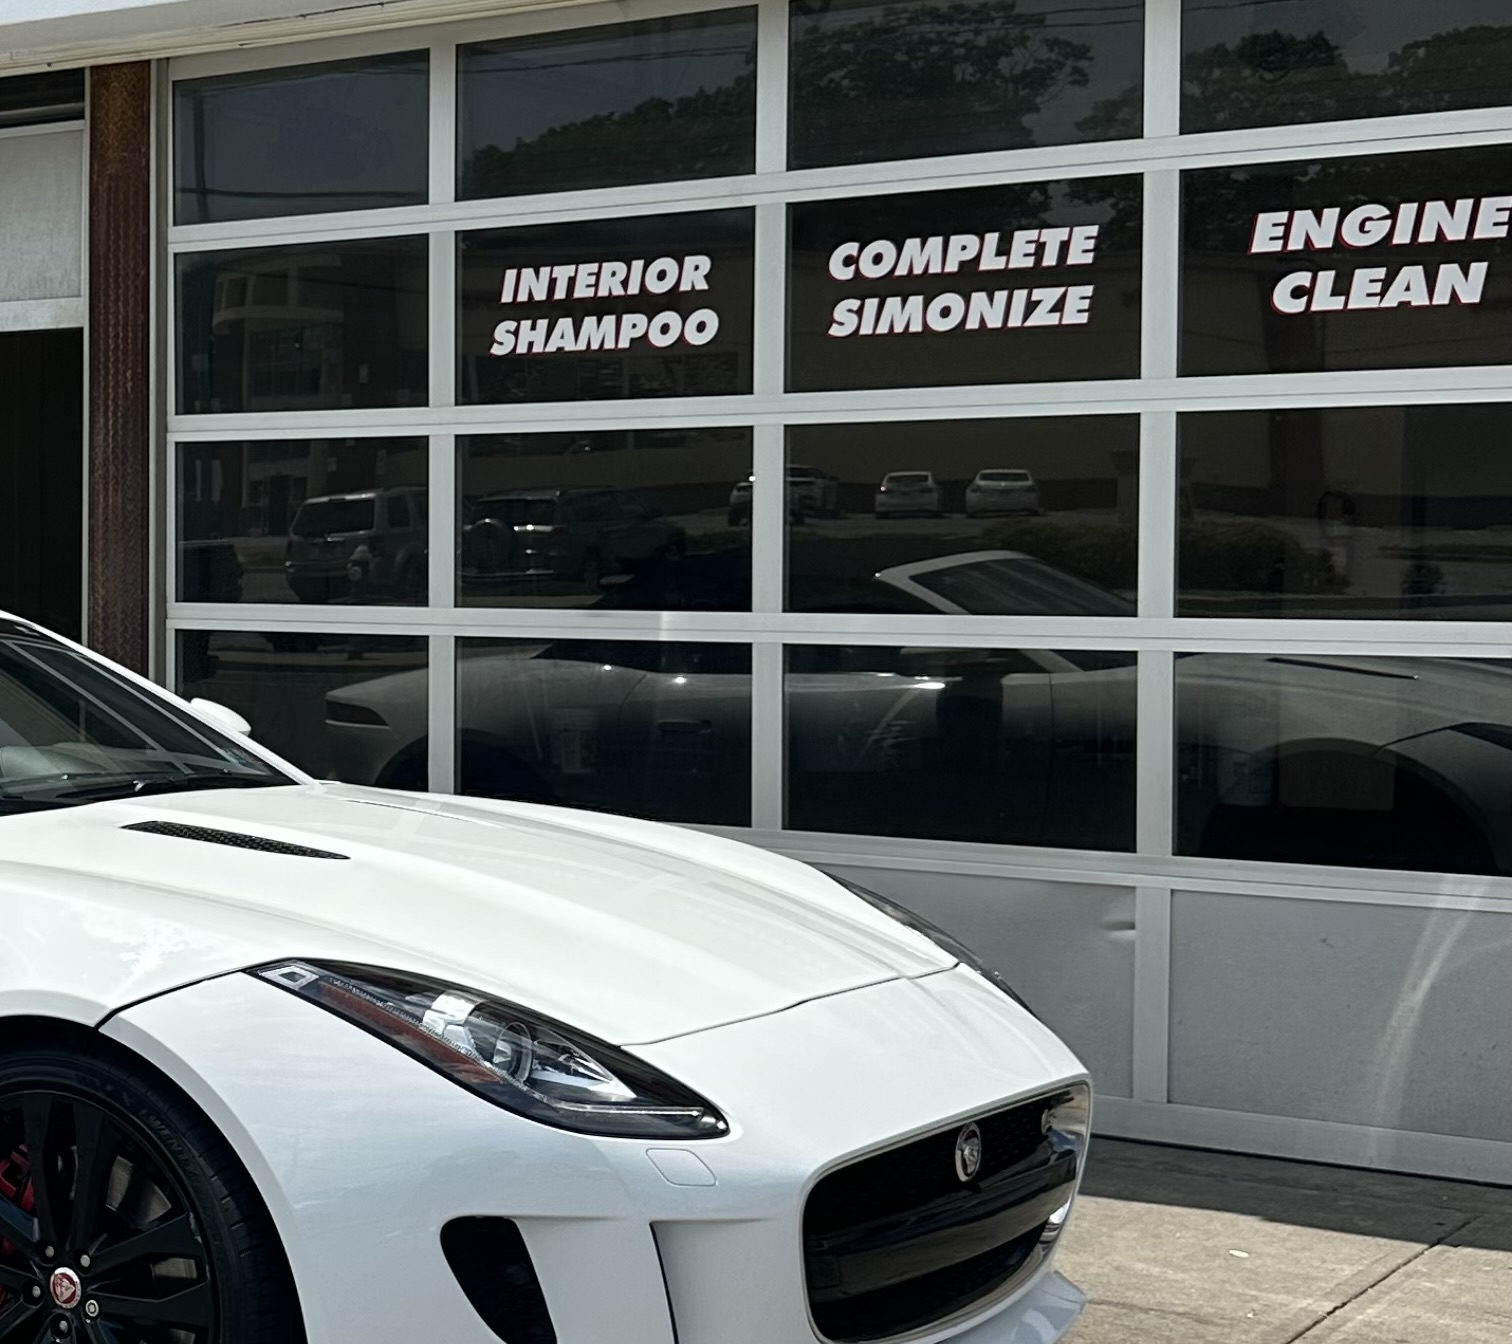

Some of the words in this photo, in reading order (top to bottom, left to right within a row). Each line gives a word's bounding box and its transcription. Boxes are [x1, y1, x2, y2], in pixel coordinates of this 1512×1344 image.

[1248, 195, 1512, 254] ENGINE
[499, 255, 711, 304] INTERIOR
[828, 224, 1100, 282] COMPLETE
[827, 285, 1095, 337] SIMONIZE
[1270, 261, 1489, 315] CLEAN
[489, 308, 719, 356] SHAMPOO
